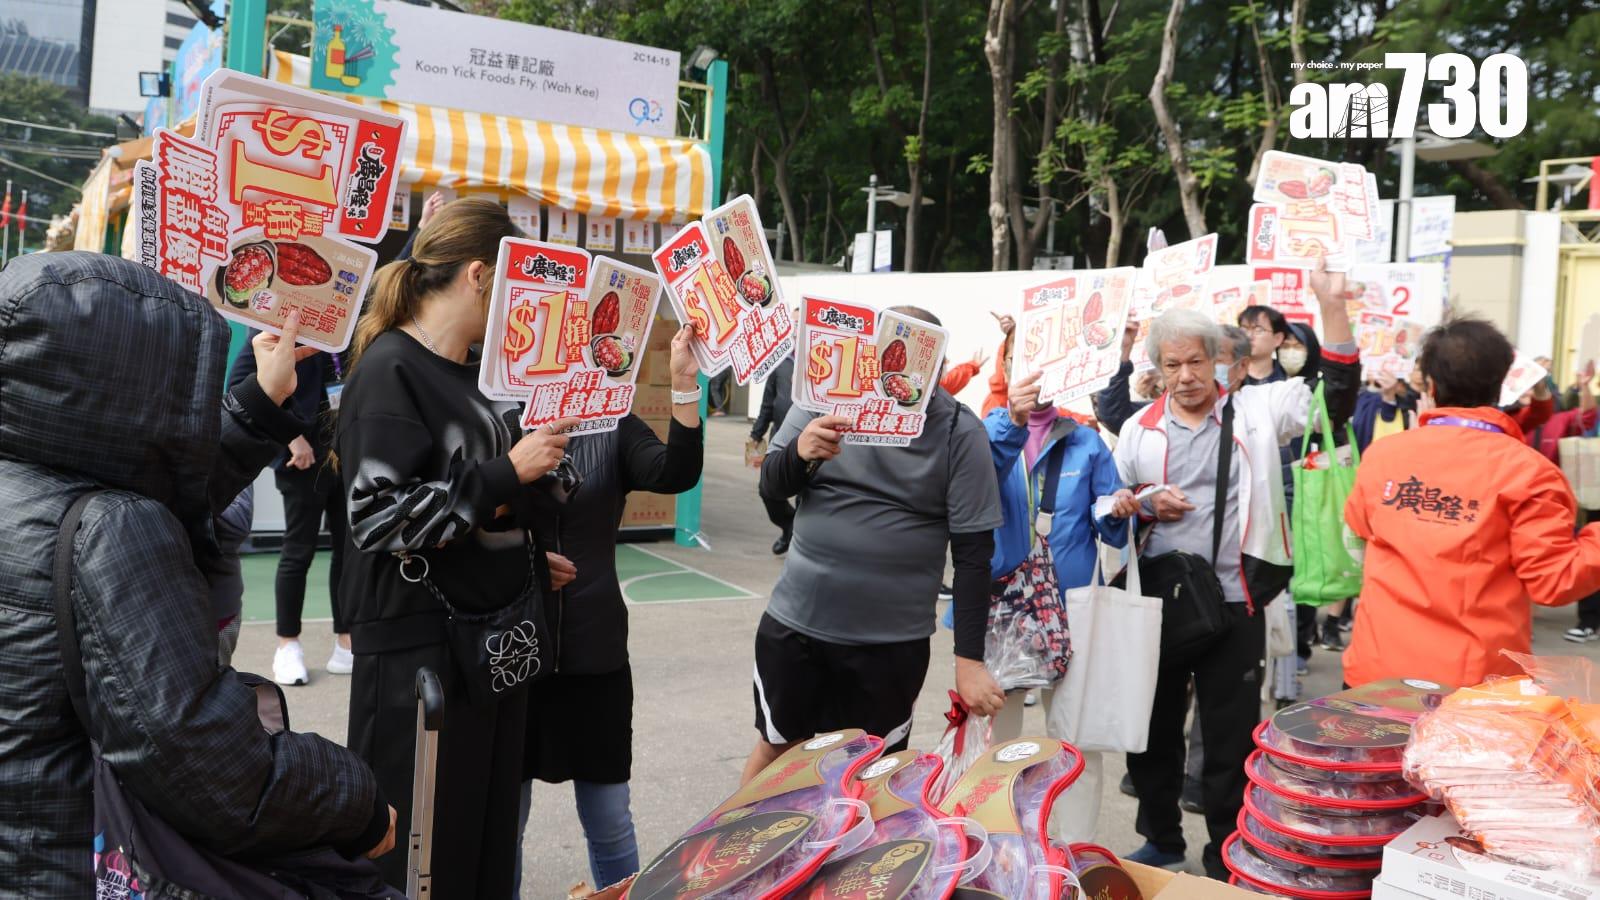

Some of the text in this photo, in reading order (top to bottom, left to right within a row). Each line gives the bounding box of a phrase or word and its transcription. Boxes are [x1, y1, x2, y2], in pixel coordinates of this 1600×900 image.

[469, 48, 555, 77] 冠益華記廠
[633, 52, 671, 67] 2C14-15
[415, 60, 600, 100] Koon Yick Foods Fty. (Wah Kee)
[350, 143, 385, 212] 廣昌隆
[202, 204, 229, 262] 每日
[524, 255, 568, 281] 廣昌隆
[1391, 285, 1411, 316] 2
[504, 291, 568, 376] $1
[570, 371, 604, 391] 每日
[808, 336, 863, 398] $1
[864, 398, 895, 414] 每日
[1382, 475, 1464, 521] 廣昌隆
